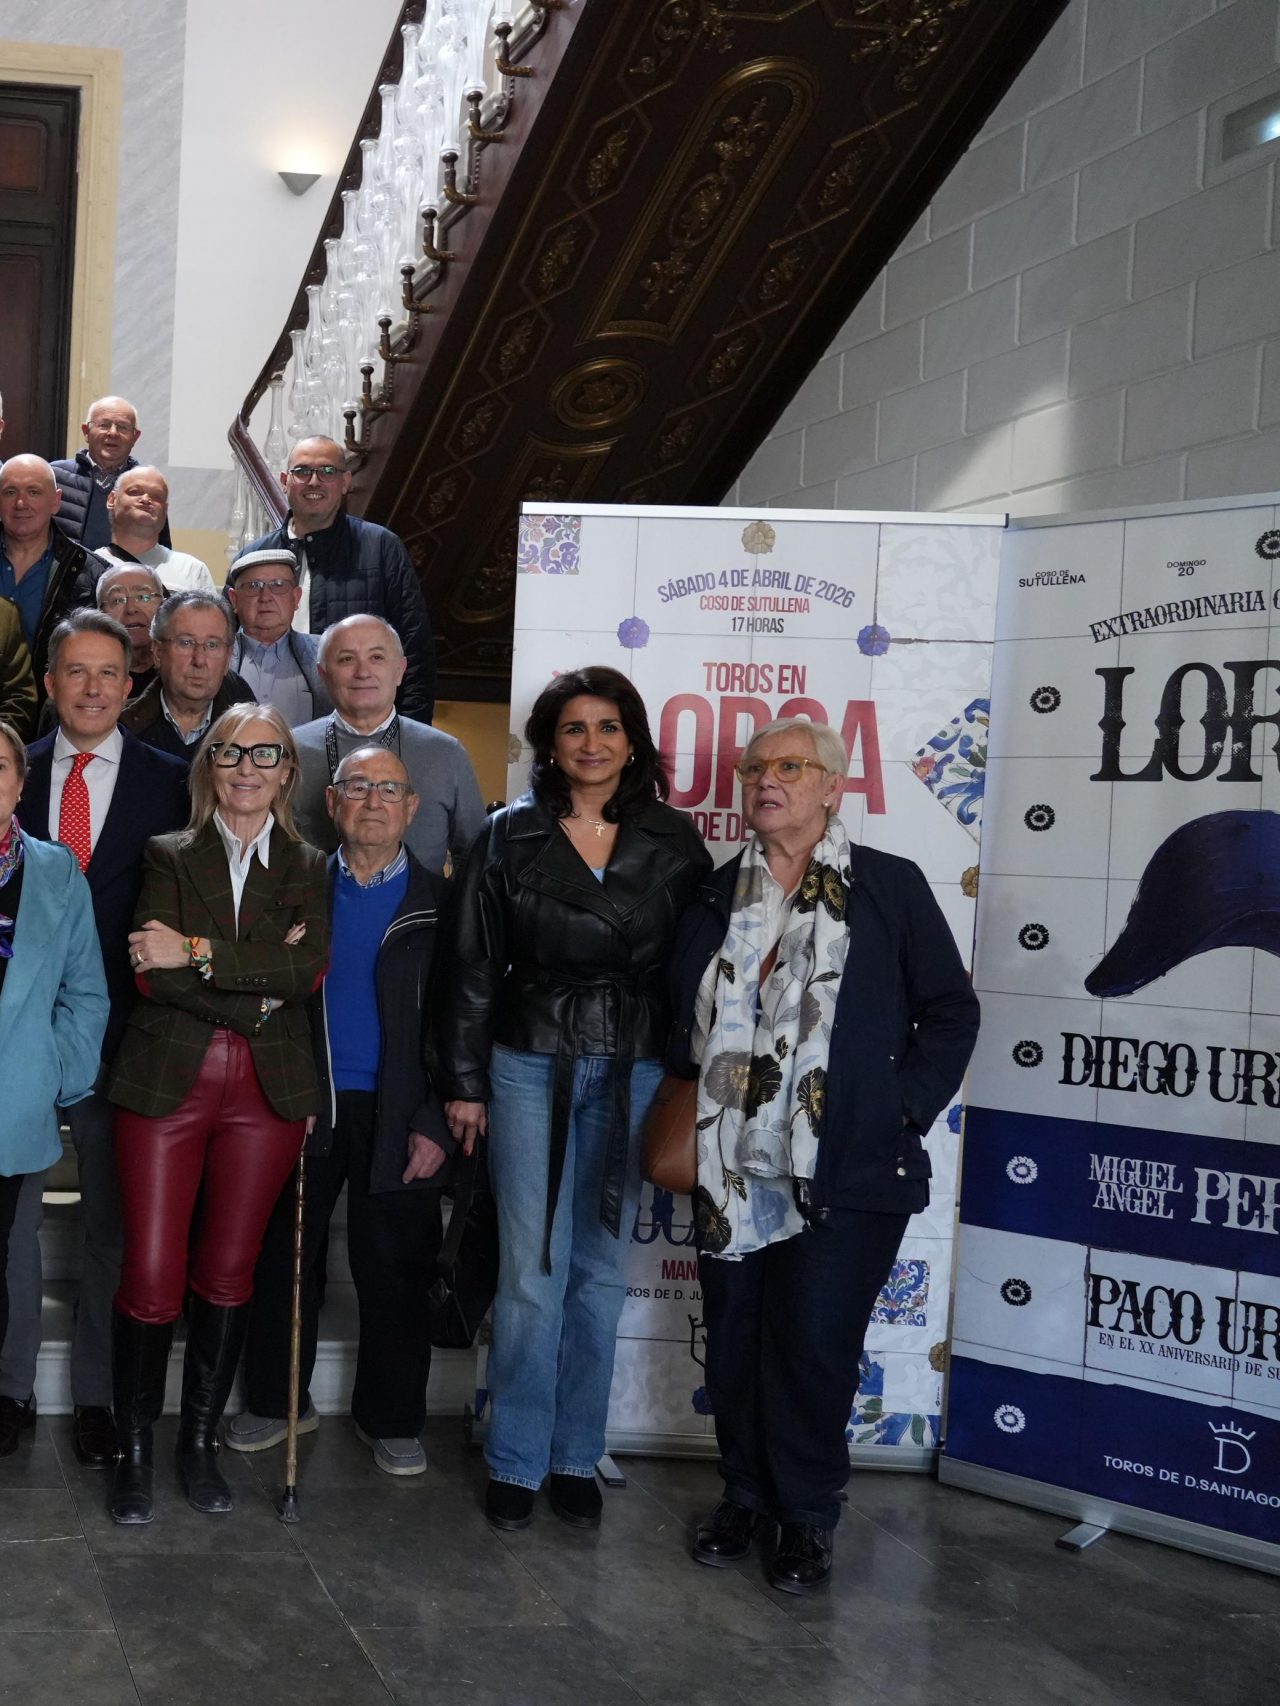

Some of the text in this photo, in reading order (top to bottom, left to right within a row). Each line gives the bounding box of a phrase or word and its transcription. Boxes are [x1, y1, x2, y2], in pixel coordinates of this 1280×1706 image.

[1035, 569, 1070, 578] COSO DE
[1166, 559, 1207, 569] DOMINGO
[1178, 566, 1195, 577] 20
[657, 568, 856, 609] SÁBADO 4 DE ABRIL DE 2026
[1018, 574, 1086, 588] SUTULLENA
[699, 595, 810, 614] COSO DE SUTULLENA
[1088, 589, 1267, 644] EXTRAORDINARIA
[731, 617, 785, 633] 17 HORAS
[702, 662, 806, 694] TOROS EN
[1058, 1032, 1280, 1109] DIEGO UR
[1088, 1153, 1184, 1193] MIGUEL
[662, 1259, 701, 1281] MAN
[654, 1288, 670, 1299] DE
[674, 1289, 686, 1300] D.
[1087, 1273, 1206, 1345] PACO
[1099, 1332, 1115, 1347] EN
[1119, 1336, 1135, 1351] EL
[1139, 1340, 1155, 1355] XX
[1157, 1344, 1240, 1373] ANIVERSARIO
[1244, 1361, 1262, 1377] DE
[1103, 1455, 1280, 1508] TOROS DE D.SANTIAGO
